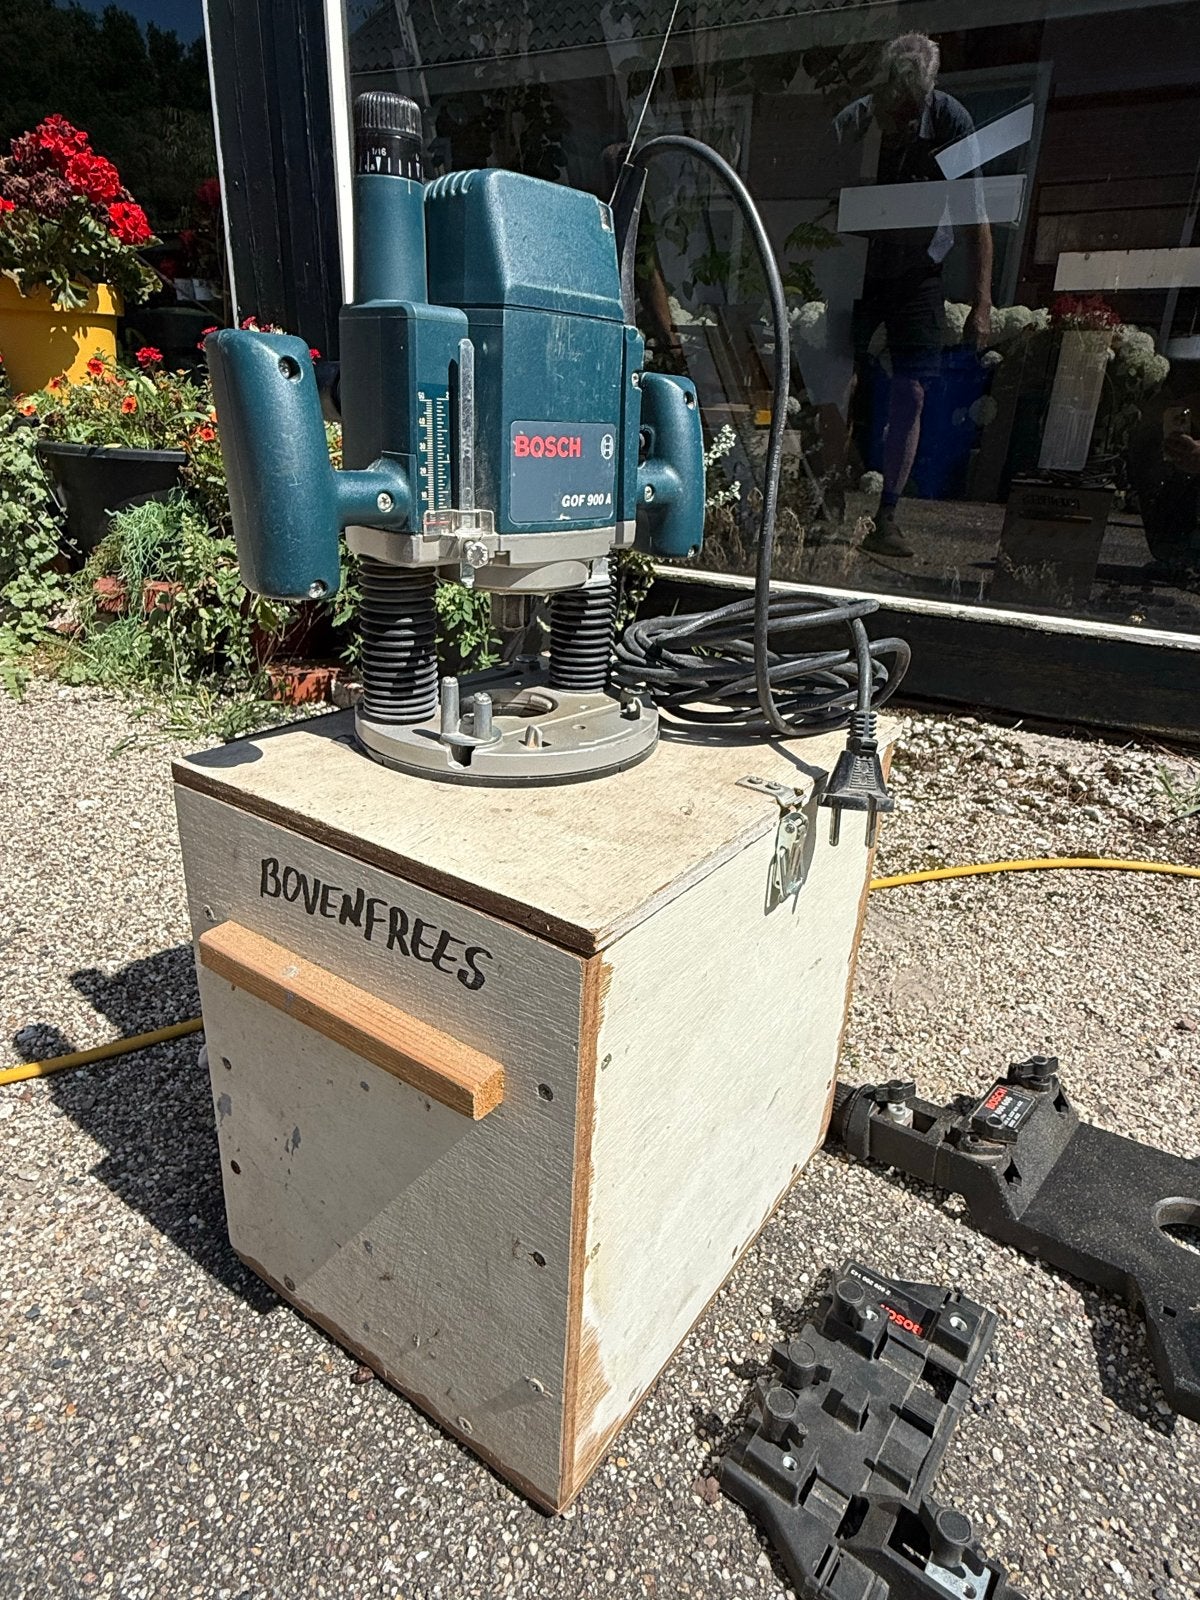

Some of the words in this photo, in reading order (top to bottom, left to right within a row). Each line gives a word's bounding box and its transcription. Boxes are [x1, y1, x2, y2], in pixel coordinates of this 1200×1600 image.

[372, 147, 387, 156] 1/16
[514, 435, 582, 459] BOSCH
[561, 495, 585, 507] GOF
[587, 493, 604, 506] 900
[605, 493, 612, 504] A
[260, 857, 493, 991] BOVENFREES
[985, 1087, 1008, 1110] BOSCH
[880, 1304, 923, 1335] BOSC
